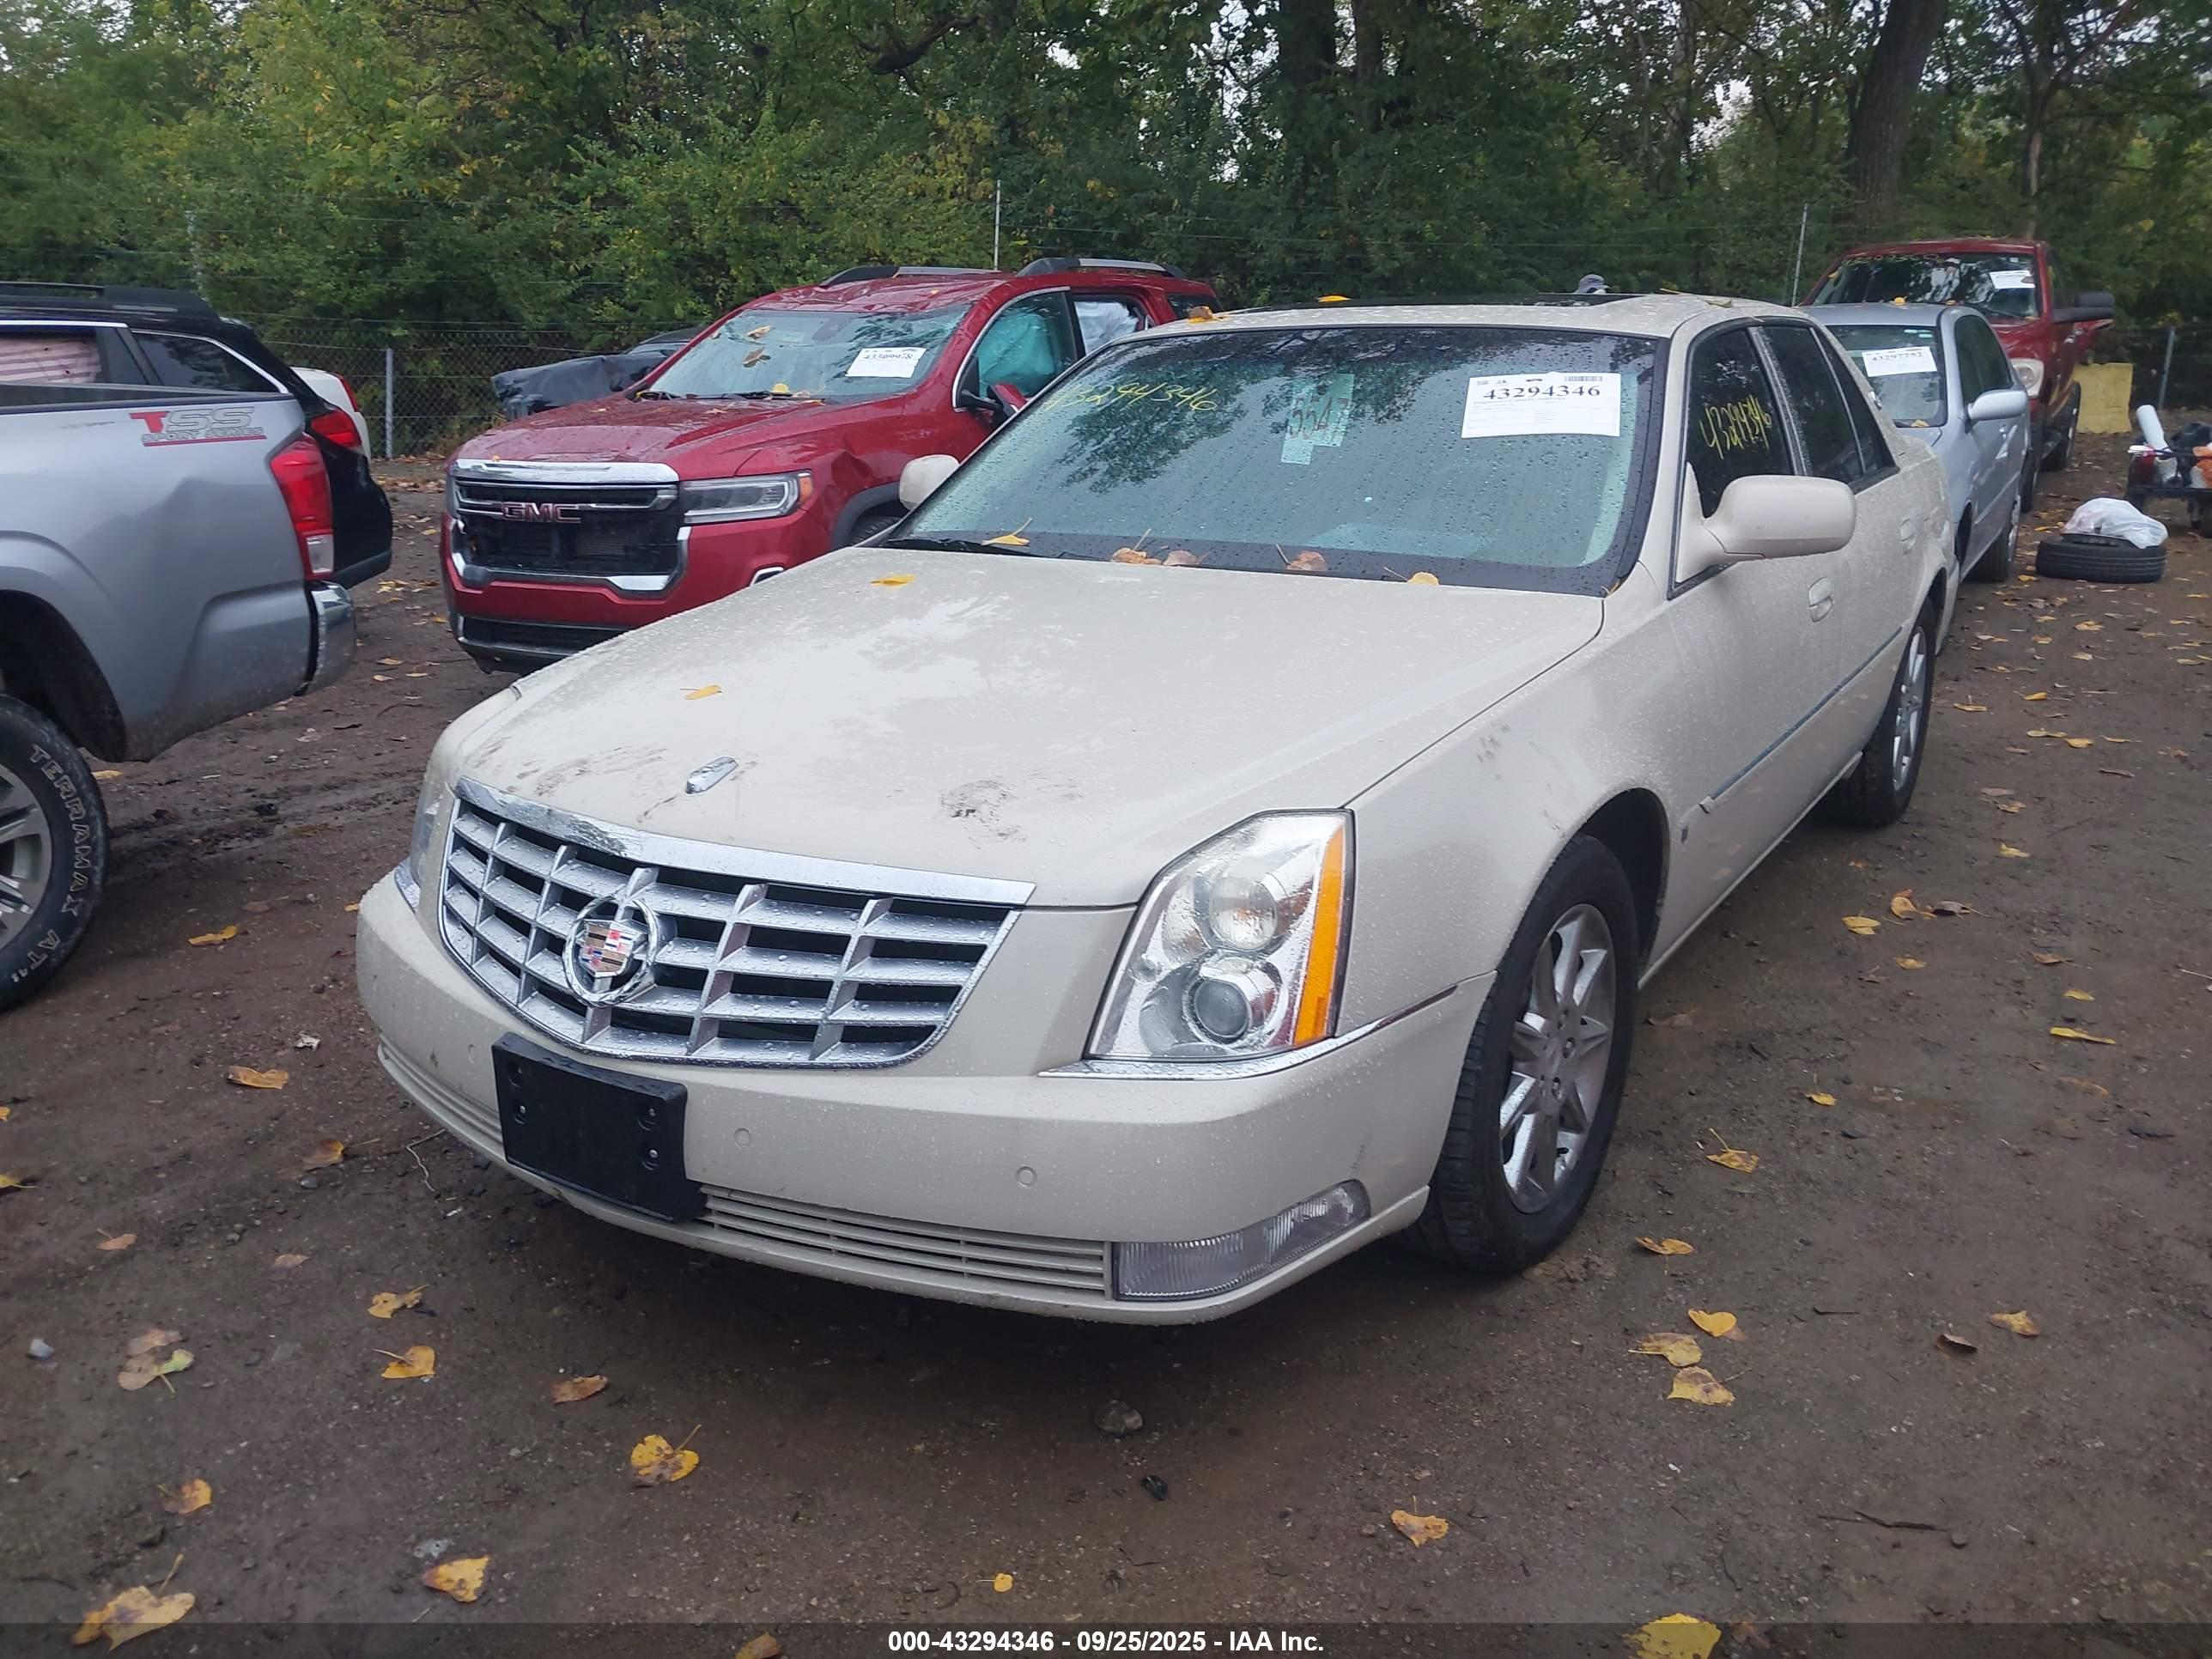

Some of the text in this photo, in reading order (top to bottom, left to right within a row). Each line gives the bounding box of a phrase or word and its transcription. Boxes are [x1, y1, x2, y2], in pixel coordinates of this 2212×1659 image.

[1482, 384, 1601, 400] 43294346
[140, 426, 264, 443] SPORT SERIES
[501, 501, 582, 524] GMC
